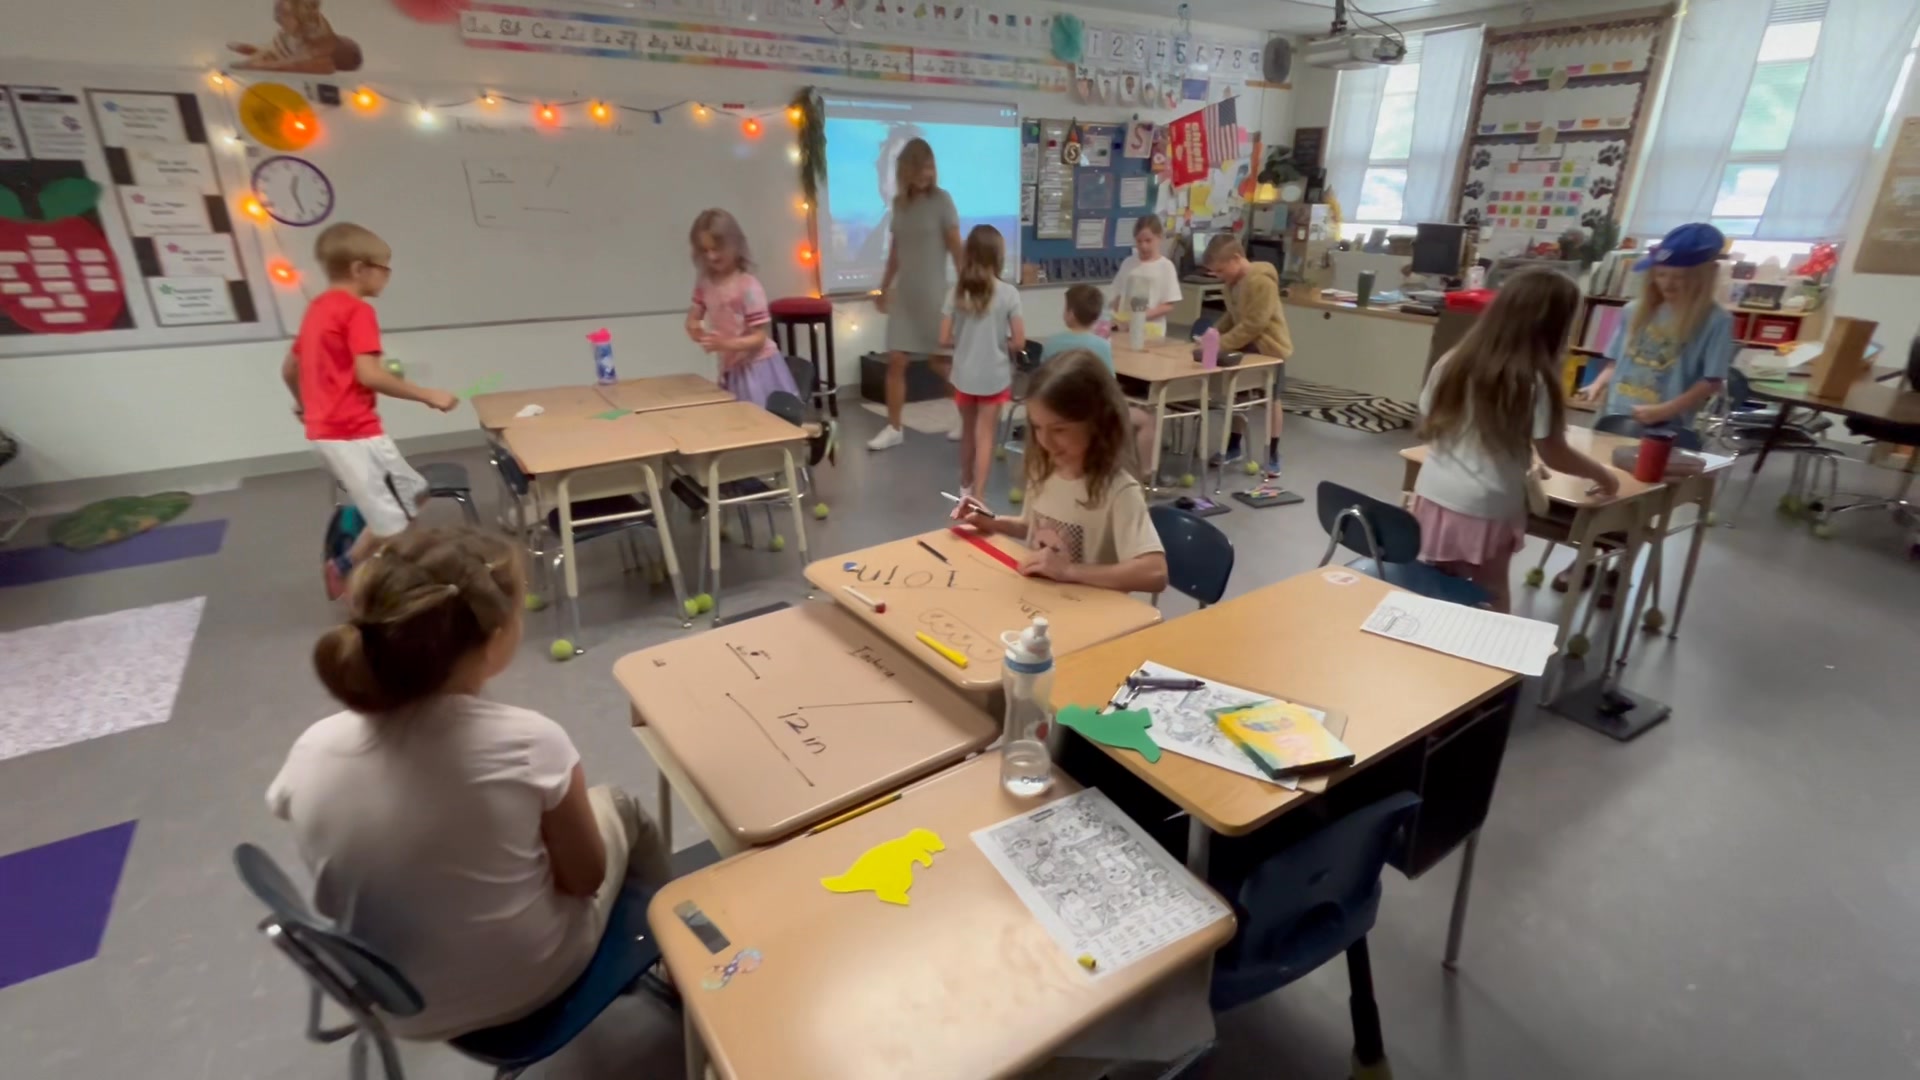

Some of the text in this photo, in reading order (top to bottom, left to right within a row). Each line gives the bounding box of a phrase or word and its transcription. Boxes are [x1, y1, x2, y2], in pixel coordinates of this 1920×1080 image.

[1112, 36, 1124, 57] 2
[1135, 38, 1145, 60] 3
[1156, 41, 1167, 58] 4
[1215, 48, 1225, 67] 7
[1232, 50, 1243, 70] 8
[1249, 52, 1260, 71] 9
[1130, 123, 1146, 151] S
[776, 711, 827, 755] 12 in
